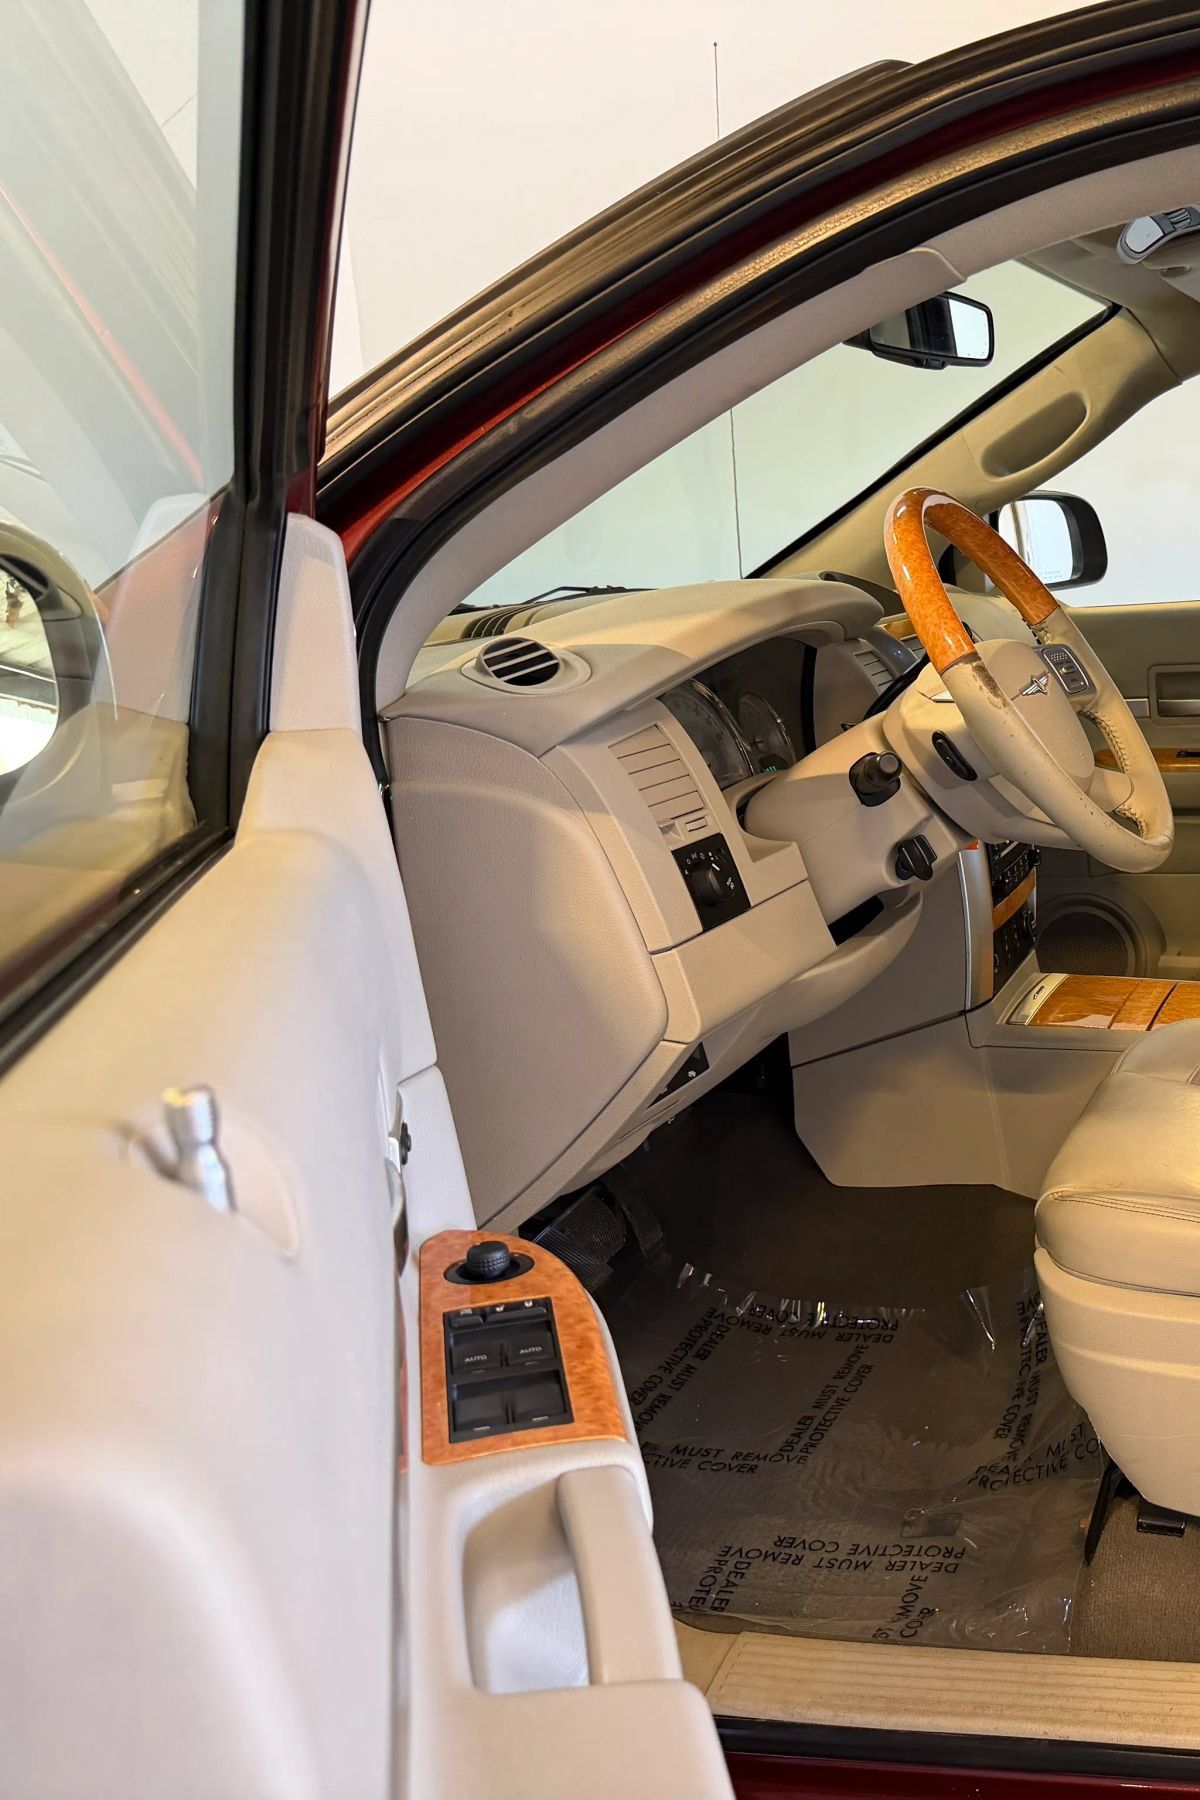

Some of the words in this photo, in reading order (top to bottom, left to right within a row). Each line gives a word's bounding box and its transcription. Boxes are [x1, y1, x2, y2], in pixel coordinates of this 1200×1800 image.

[520, 1346, 543, 1355] AUTO
[657, 1317, 714, 1375] PROTECTIVE
[693, 1323, 731, 1361] DEALER
[464, 1354, 488, 1363] AUTO
[667, 1363, 698, 1392] MUST
[629, 1374, 664, 1406] COVER
[778, 1414, 816, 1453] DEALER
[811, 1384, 841, 1410] MUST
[832, 1343, 870, 1381] REMOVE
[799, 1395, 852, 1455] PROTECTIVE
[843, 1364, 875, 1394] COVER
[992, 1404, 1021, 1440] COVER
[670, 1443, 725, 1458] MUST
[730, 1451, 809, 1465] REMOVE
[697, 1460, 760, 1474] COVER
[773, 1535, 841, 1553] COVER
[848, 1542, 967, 1559] PROTECTIVE
[717, 1545, 805, 1566] REMOVE
[812, 1556, 874, 1571] MUST
[884, 1559, 959, 1574] DEALER
